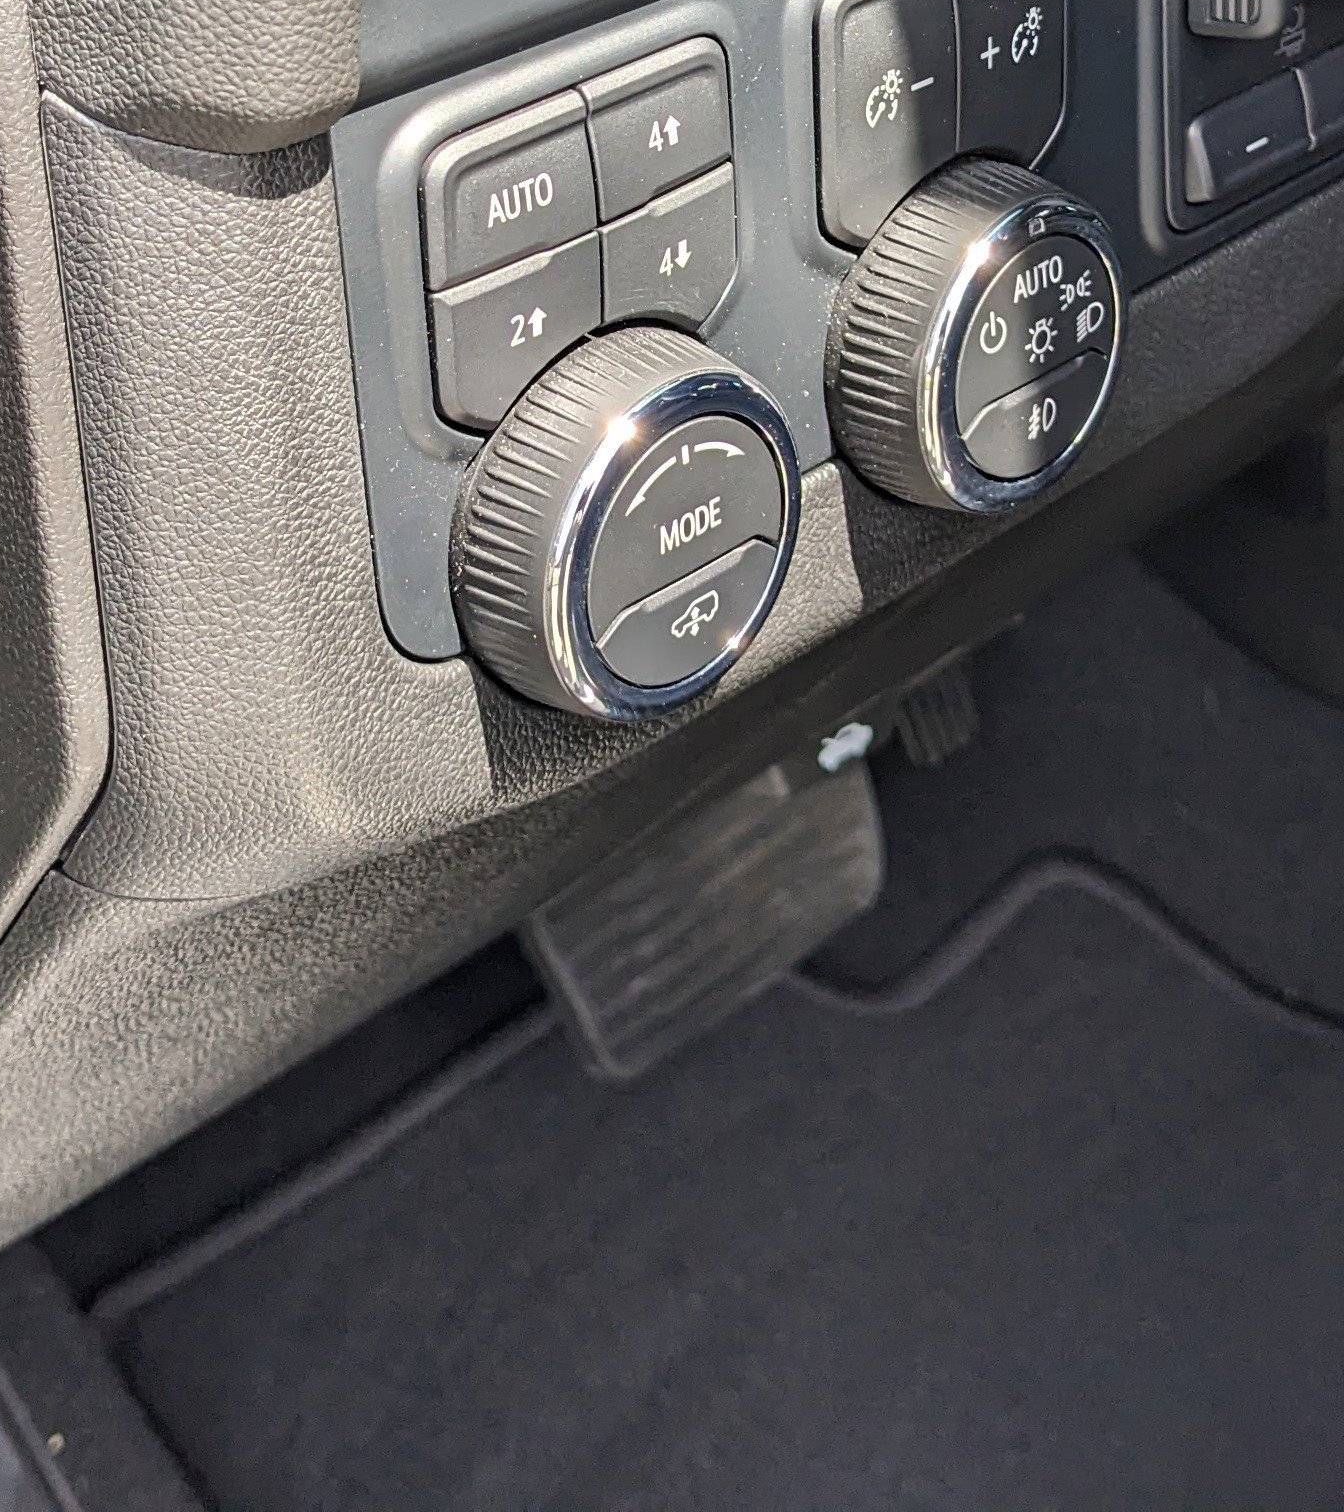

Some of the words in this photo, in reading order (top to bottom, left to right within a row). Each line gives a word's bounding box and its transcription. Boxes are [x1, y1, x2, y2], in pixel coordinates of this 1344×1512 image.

[648, 120, 664, 152] 4
[487, 172, 553, 228] AUTO
[659, 247, 674, 277] 4
[1013, 256, 1063, 302] AUTO
[510, 317, 525, 346] 2
[660, 496, 722, 555] MODE
